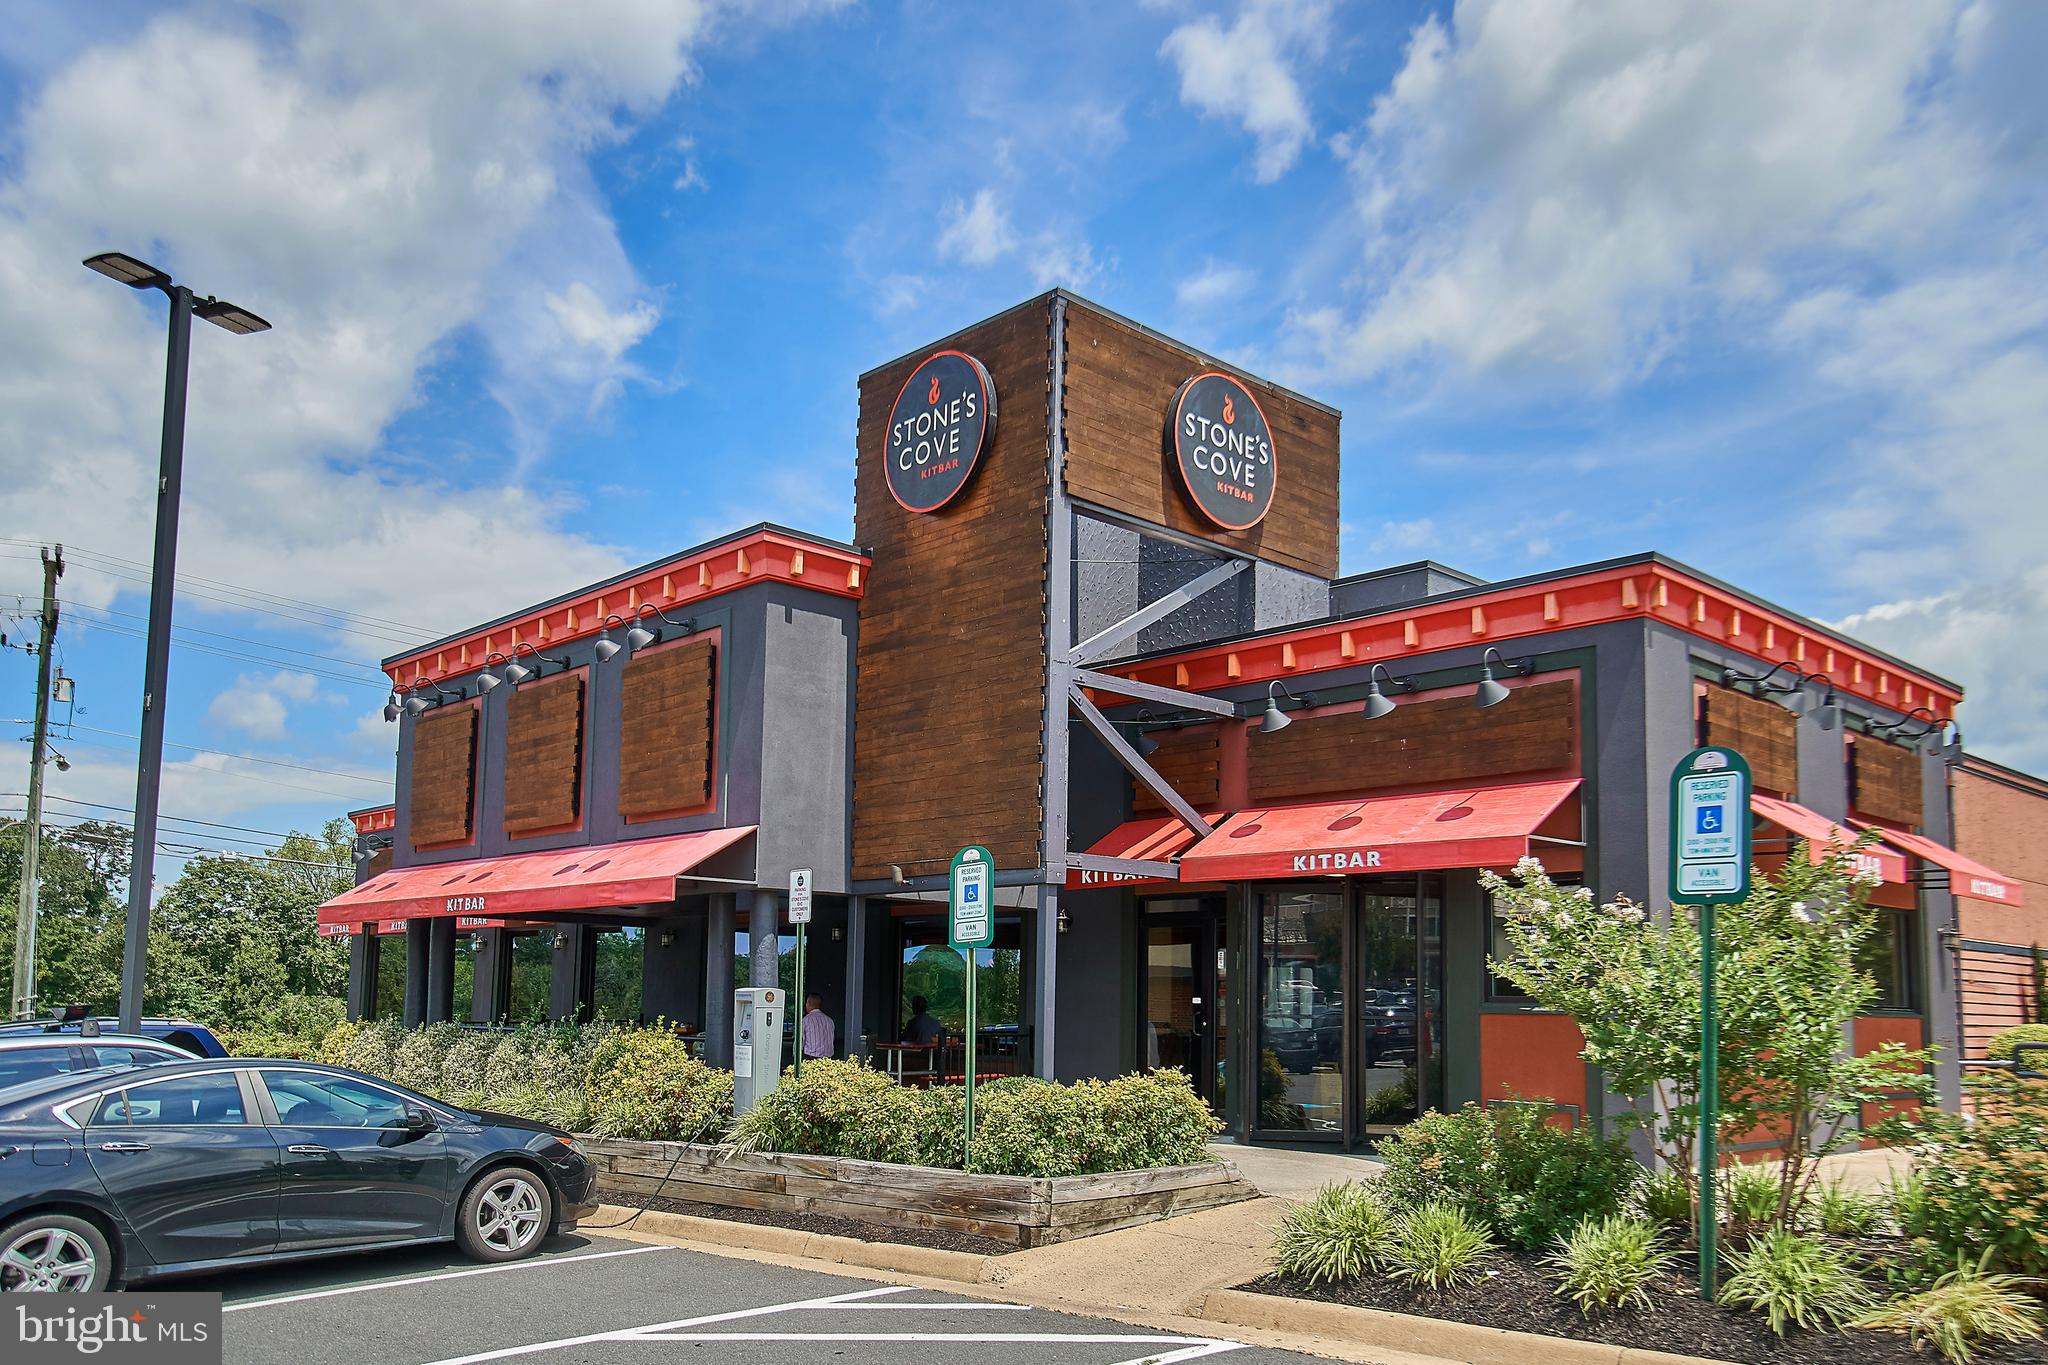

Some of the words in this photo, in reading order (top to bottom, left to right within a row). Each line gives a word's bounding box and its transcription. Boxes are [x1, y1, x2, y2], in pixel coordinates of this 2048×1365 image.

[893, 391, 976, 446] STONE'S
[1185, 412, 1269, 465] STONE'S
[899, 428, 960, 471] COVE
[920, 458, 959, 480] KITBAR
[1193, 445, 1256, 488] COVE
[1216, 481, 1254, 503] KITBAR
[1691, 780, 1729, 791] RESERVED
[1692, 792, 1727, 803] PARKING
[1293, 850, 1381, 872] KITBAR
[961, 866, 982, 875] RESERVED
[1698, 868, 1719, 877] VAN
[962, 874, 981, 883] PARKING
[447, 897, 485, 912] KITBAR
[329, 924, 350, 934] KITBAR
[461, 917, 488, 926] KITBAR
